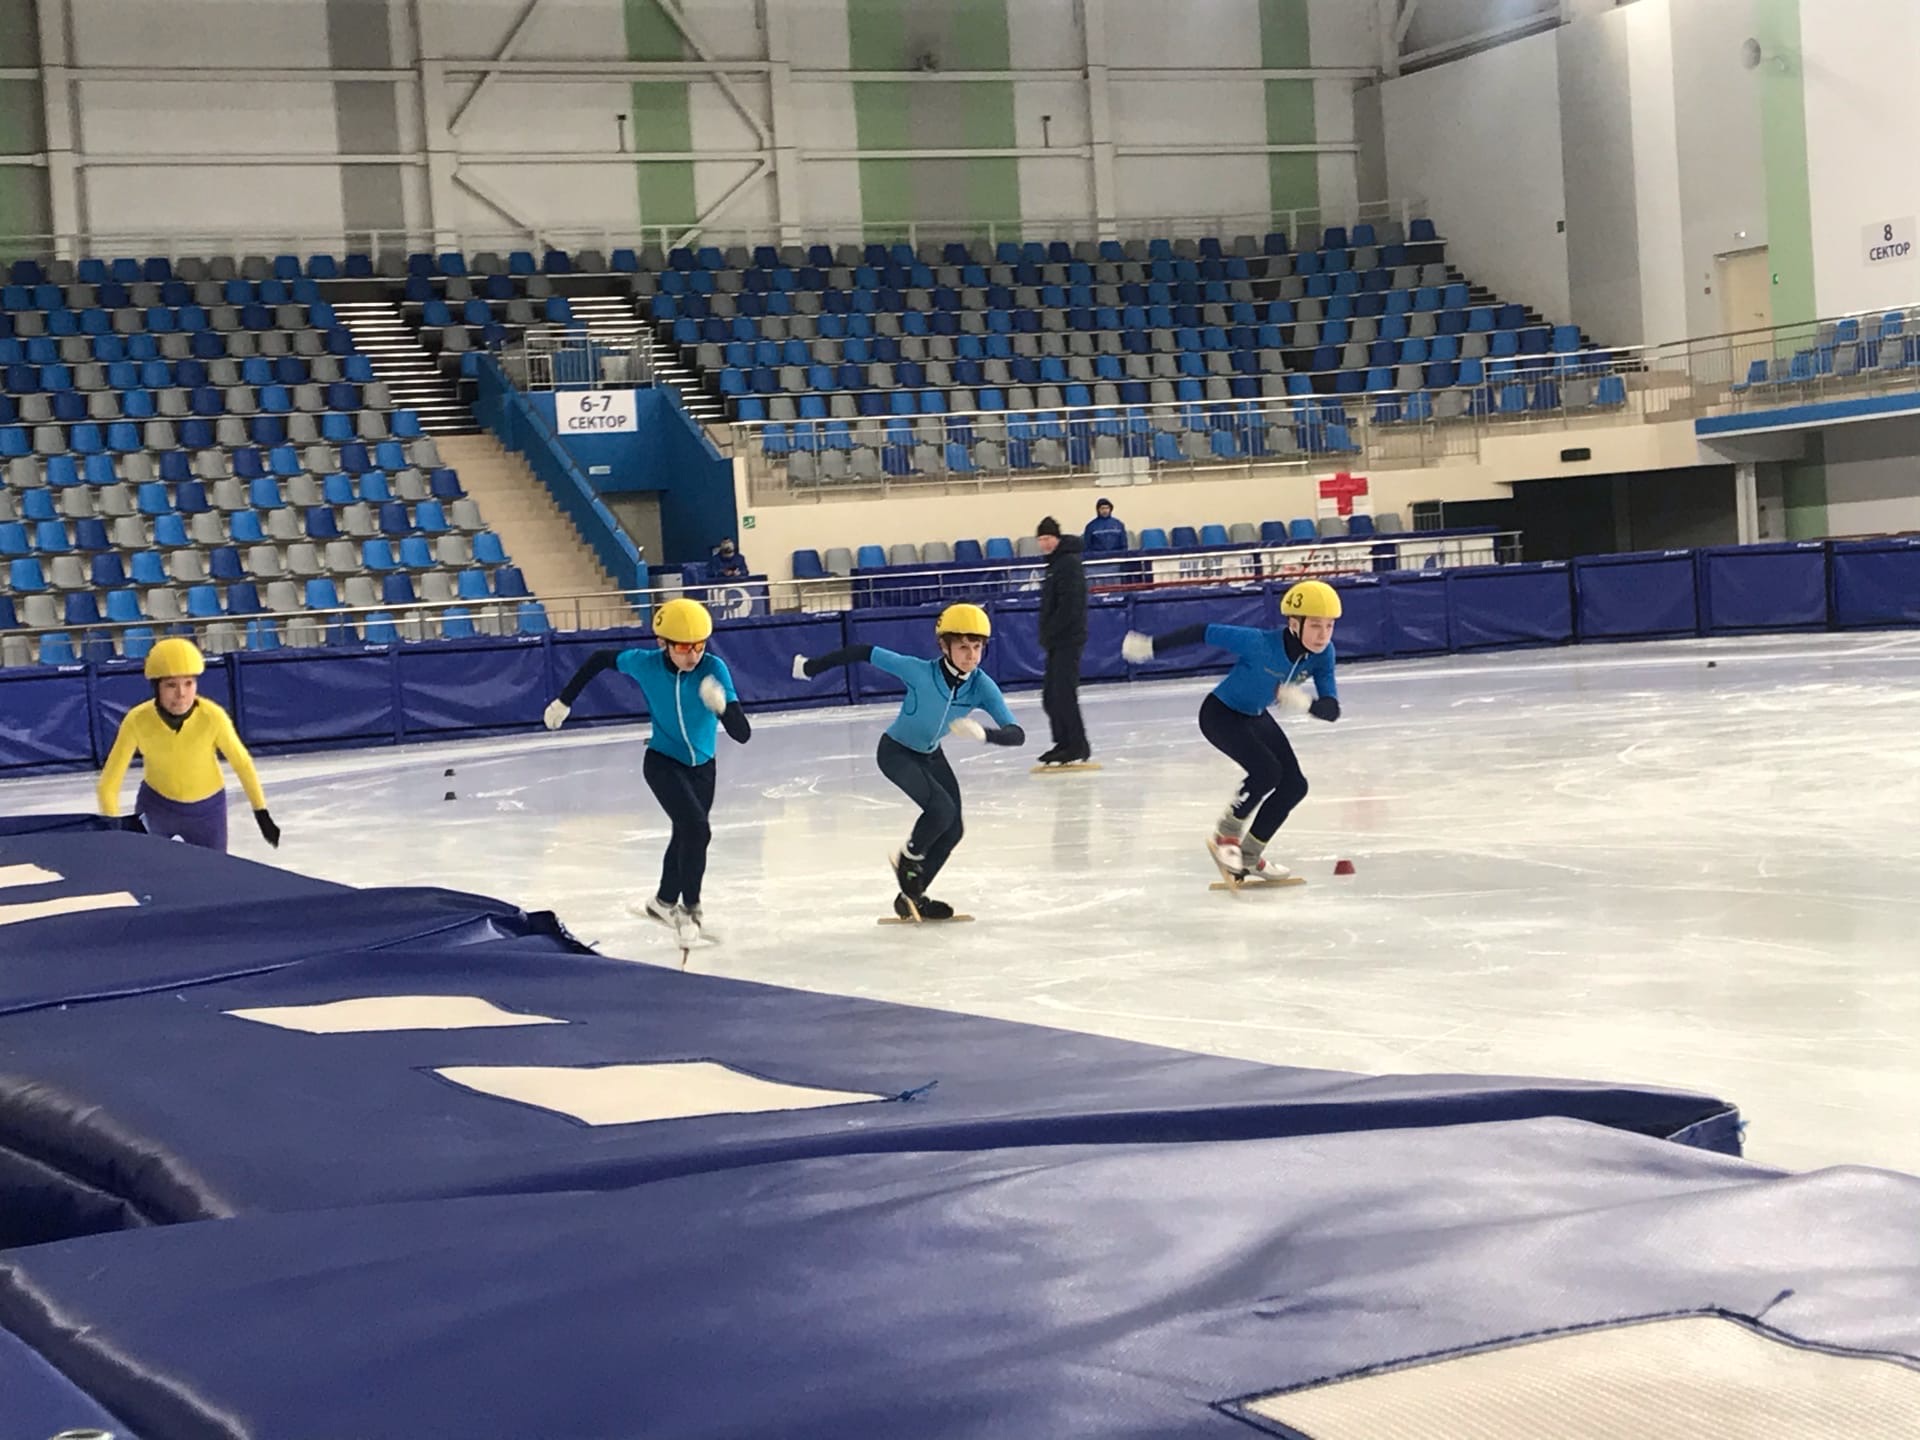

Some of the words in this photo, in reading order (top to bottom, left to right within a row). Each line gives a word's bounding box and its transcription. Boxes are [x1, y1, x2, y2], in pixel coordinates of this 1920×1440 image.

[1883, 223, 1893, 241] 8
[1869, 241, 1911, 261] СЕКТОР
[580, 395, 612, 413] 6-7
[568, 415, 627, 430] СЕКТОР
[1285, 592, 1304, 609] 43
